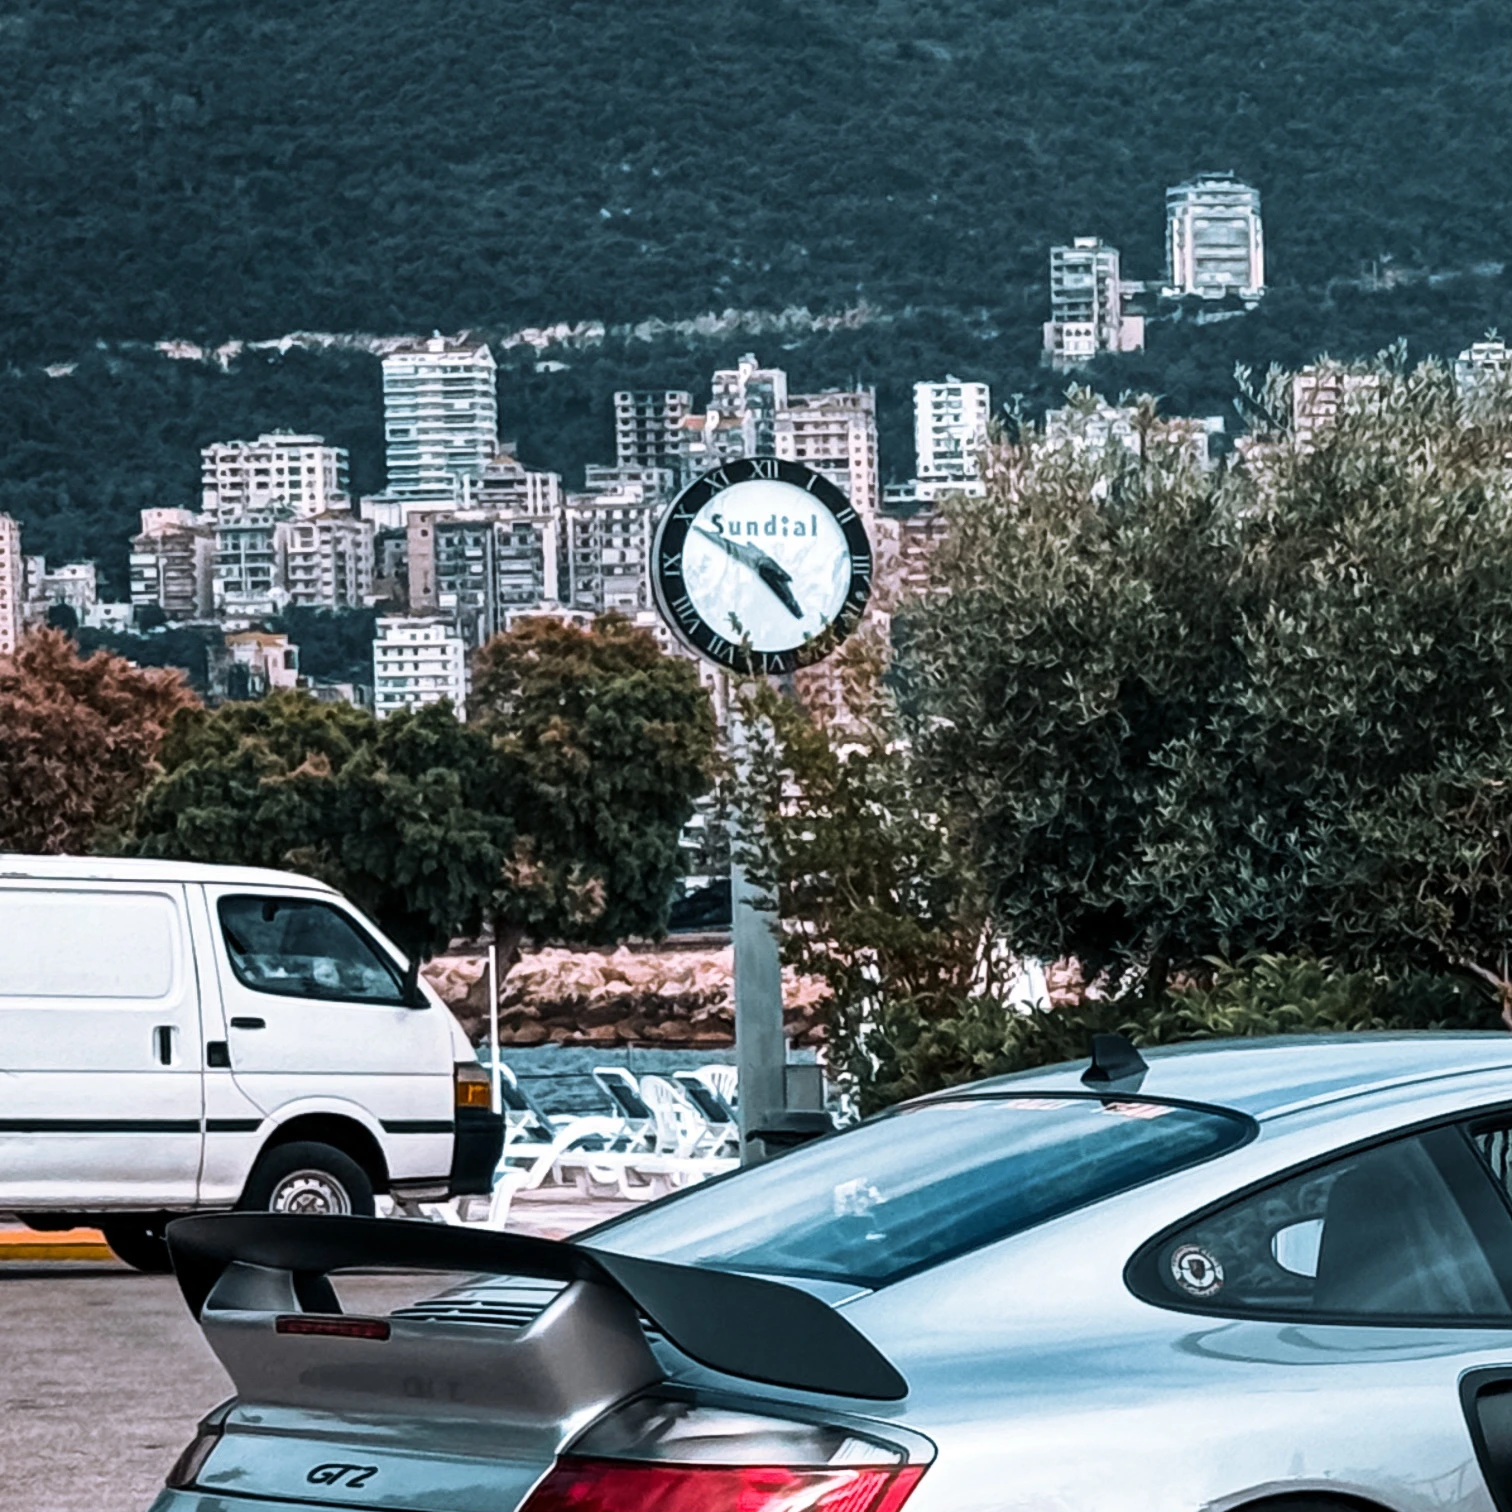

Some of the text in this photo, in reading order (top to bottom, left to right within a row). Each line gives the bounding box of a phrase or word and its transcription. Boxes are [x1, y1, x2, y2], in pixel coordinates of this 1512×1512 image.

[751, 460, 779, 478] XII
[711, 513, 818, 537] Sundial
[836, 507, 856, 524] II
[663, 552, 682, 576] IX
[852, 555, 870, 575] III
[672, 594, 700, 634] VIII
[306, 1463, 379, 1489] GT2
